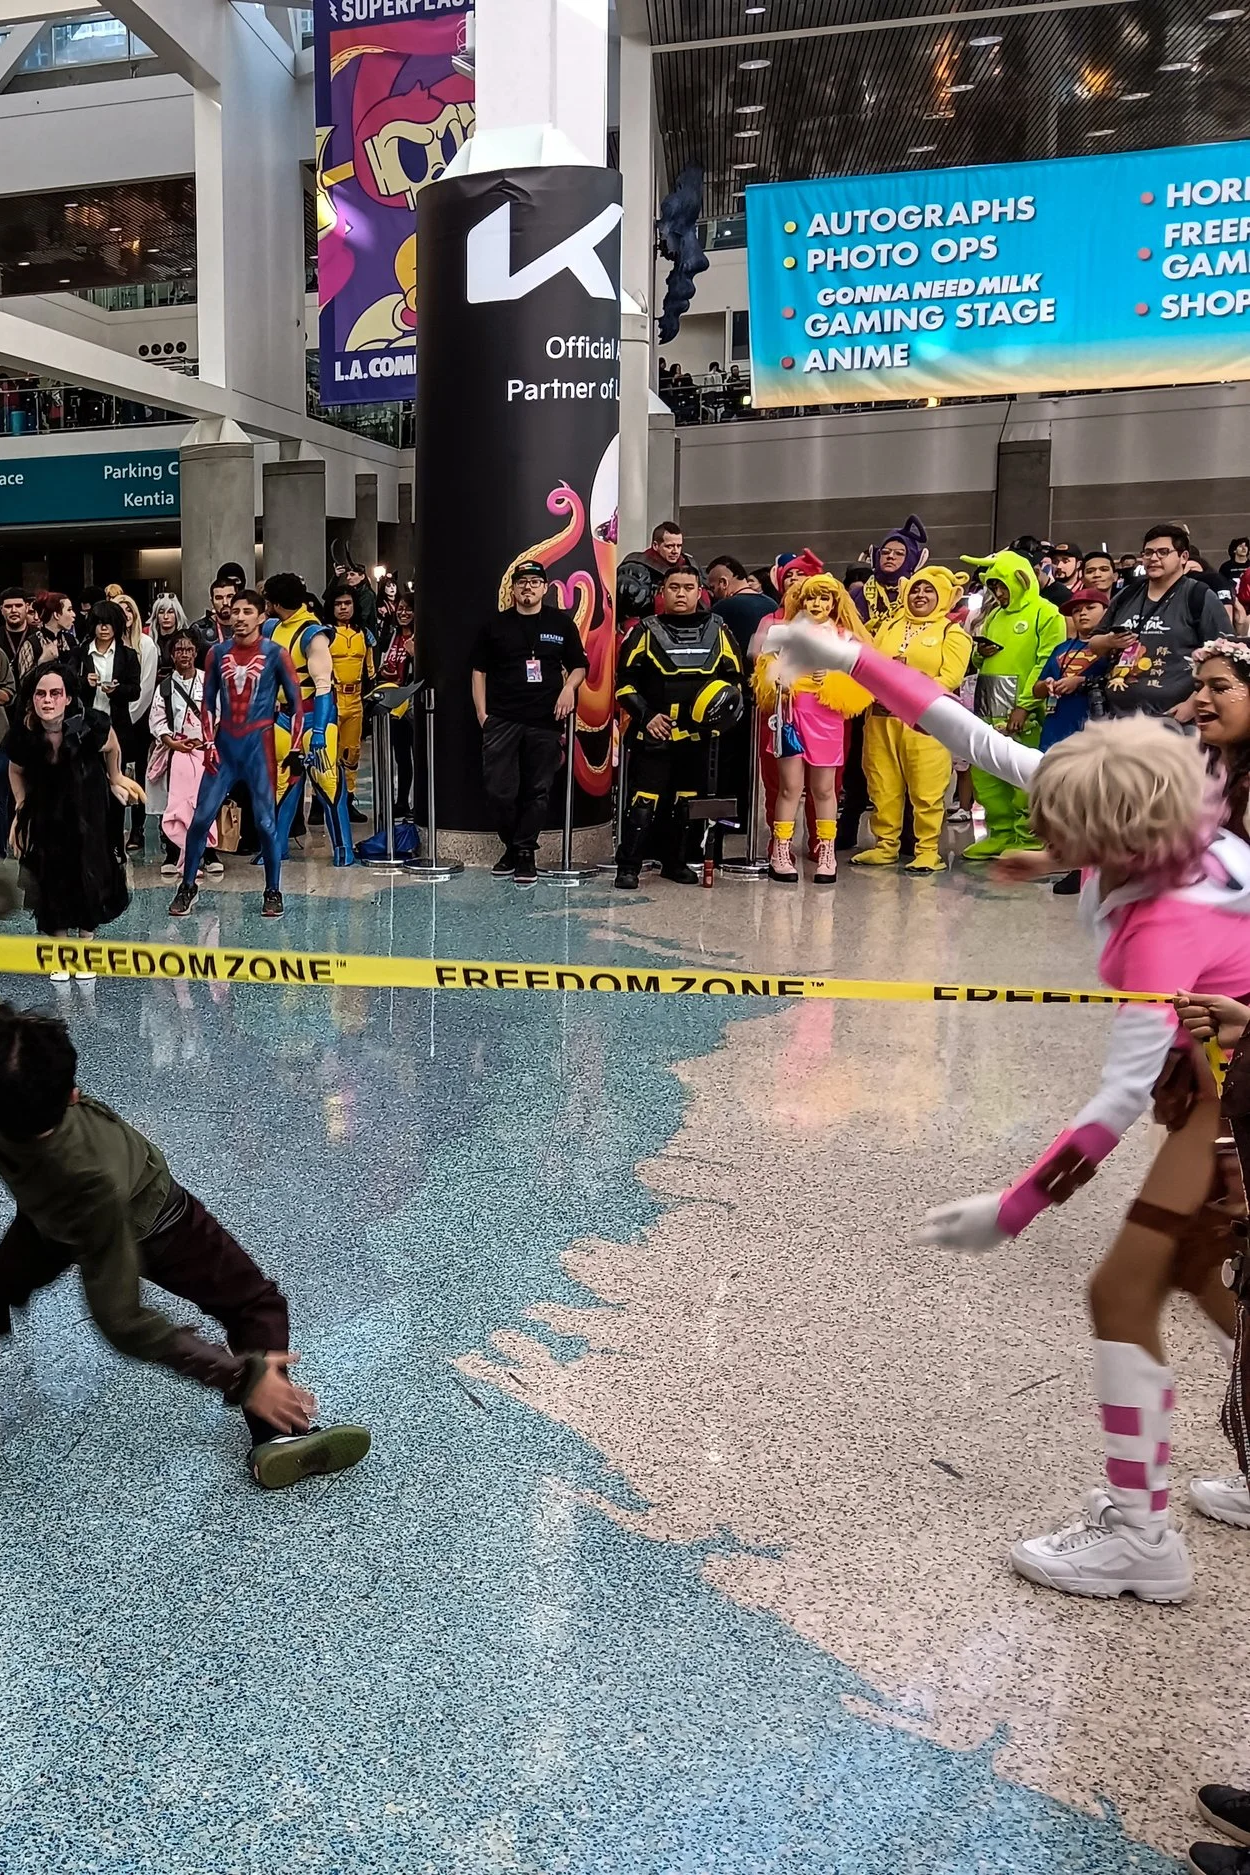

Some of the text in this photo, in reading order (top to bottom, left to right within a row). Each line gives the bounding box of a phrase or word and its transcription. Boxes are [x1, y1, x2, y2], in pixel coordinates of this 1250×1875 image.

[1166, 177, 1250, 208] HOR
[807, 196, 1036, 237] AUTOGRAPHS
[807, 236, 998, 273] PHOTO OPS
[816, 273, 1042, 307] GONNA NEED MILK
[804, 299, 1056, 338] GAMING STAGE
[546, 336, 615, 360] Official
[803, 343, 910, 373] ANIME
[507, 379, 597, 402] Partner
[600, 378, 614, 399] of
[103, 463, 163, 481] Parking
[123, 490, 175, 507] Kentia
